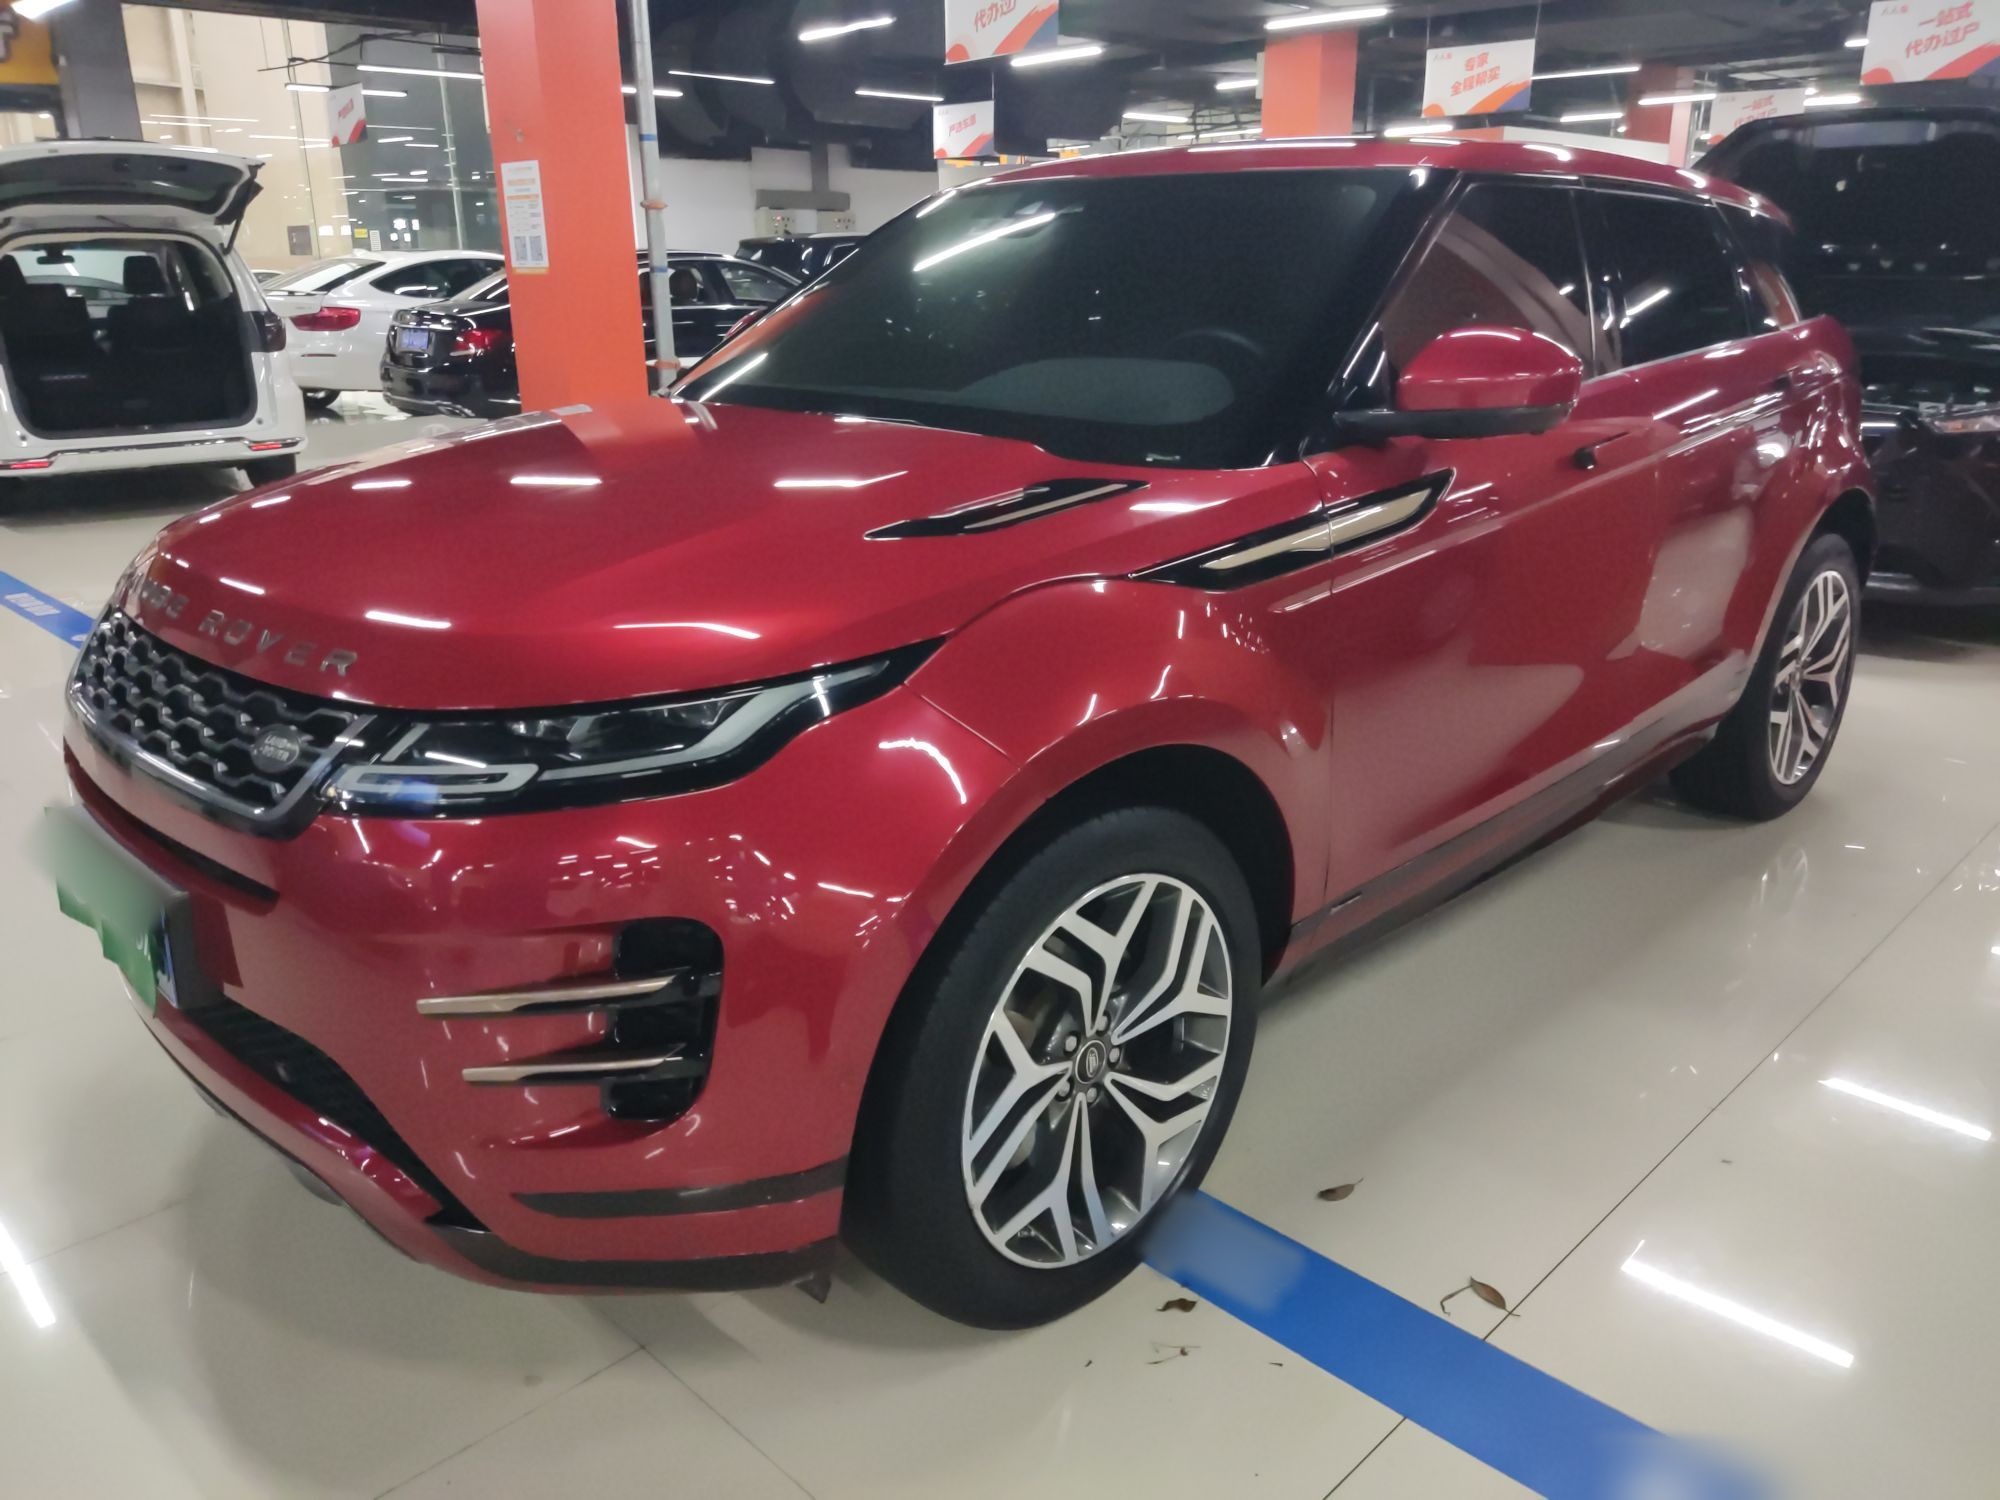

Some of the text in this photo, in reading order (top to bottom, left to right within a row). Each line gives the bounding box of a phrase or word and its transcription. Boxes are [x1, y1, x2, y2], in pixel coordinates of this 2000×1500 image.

[1918, 0, 1975, 27] 一站式
[1904, 21, 1980, 59] 代办过户
[198, 608, 358, 677] ROVER
